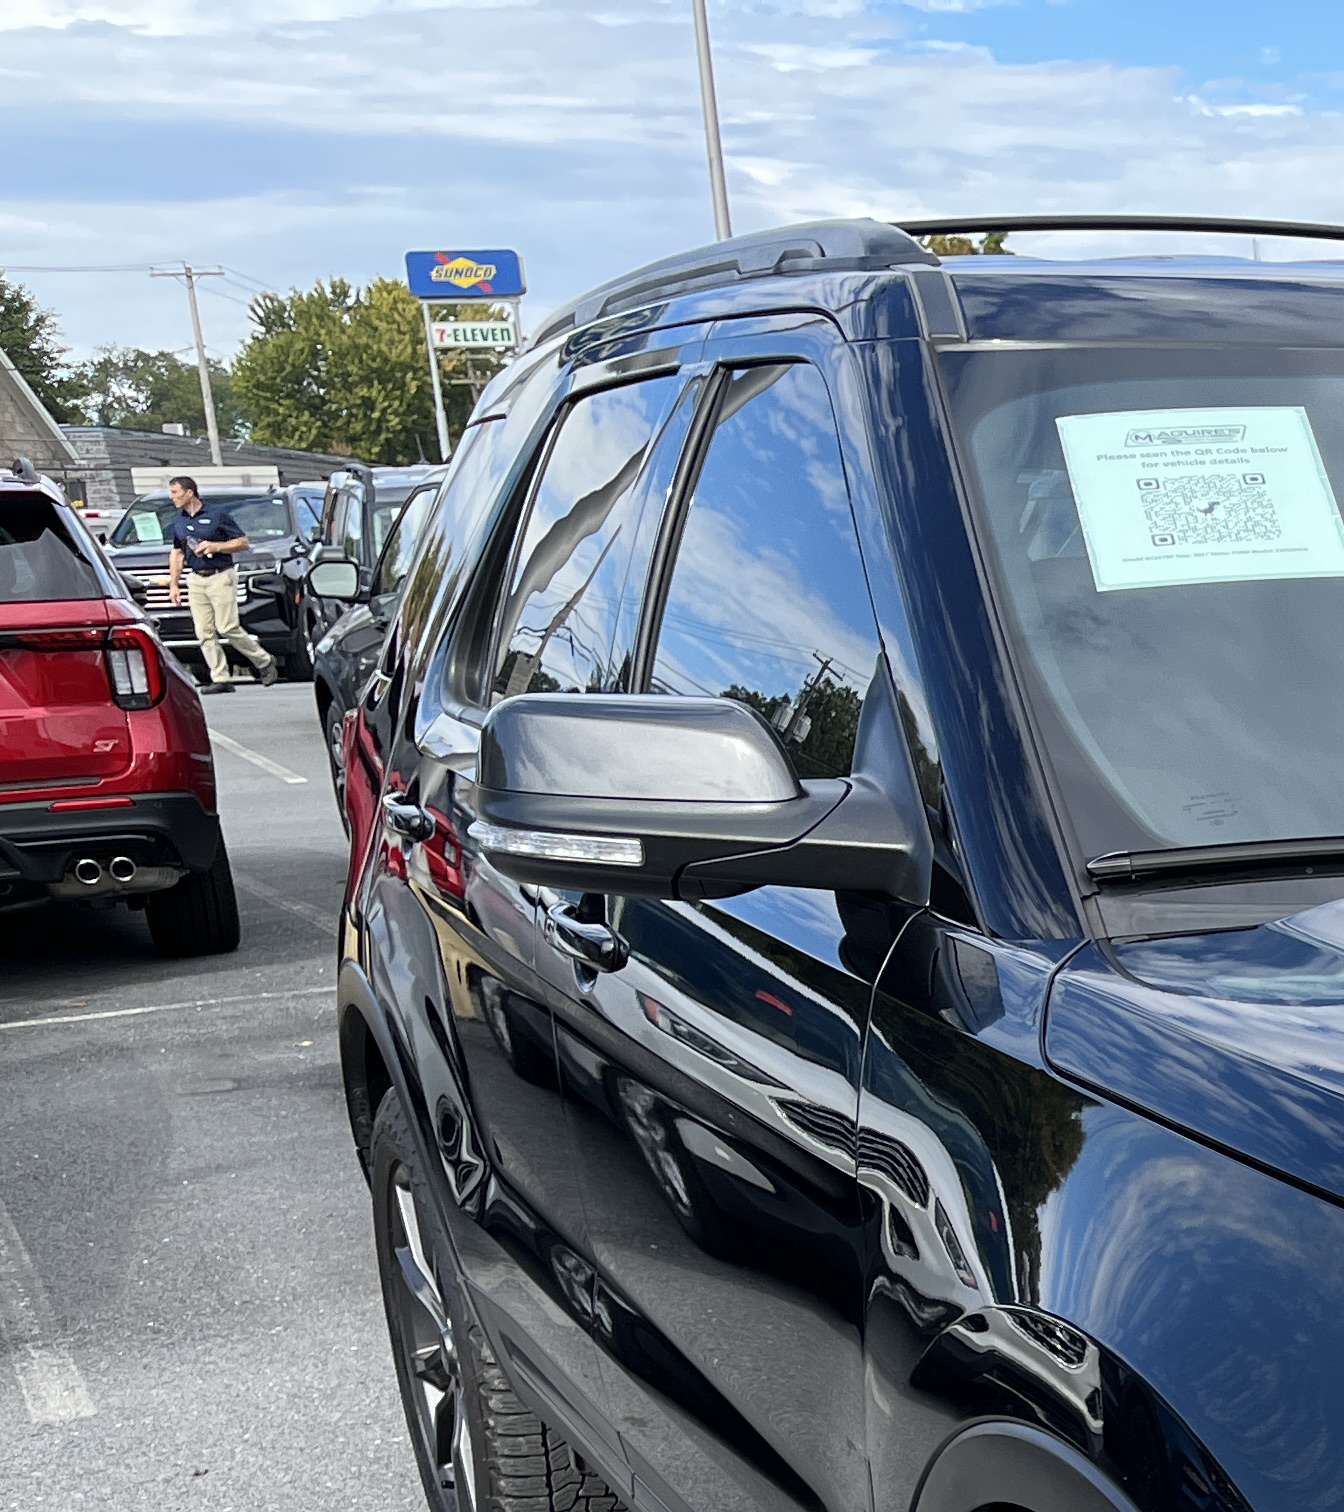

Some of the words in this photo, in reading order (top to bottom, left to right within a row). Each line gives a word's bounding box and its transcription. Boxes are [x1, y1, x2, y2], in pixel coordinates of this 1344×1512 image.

[435, 267, 493, 279] SUNOCO
[1096, 452, 1137, 461] Please
[1140, 451, 1167, 459] scan
[1170, 449, 1191, 457] the
[1194, 448, 1213, 456] QR
[1216, 446, 1248, 455] Code
[1250, 445, 1288, 454] below
[1141, 461, 1159, 469] for
[1162, 458, 1207, 467] vehicle
[1209, 456, 1251, 466] details
